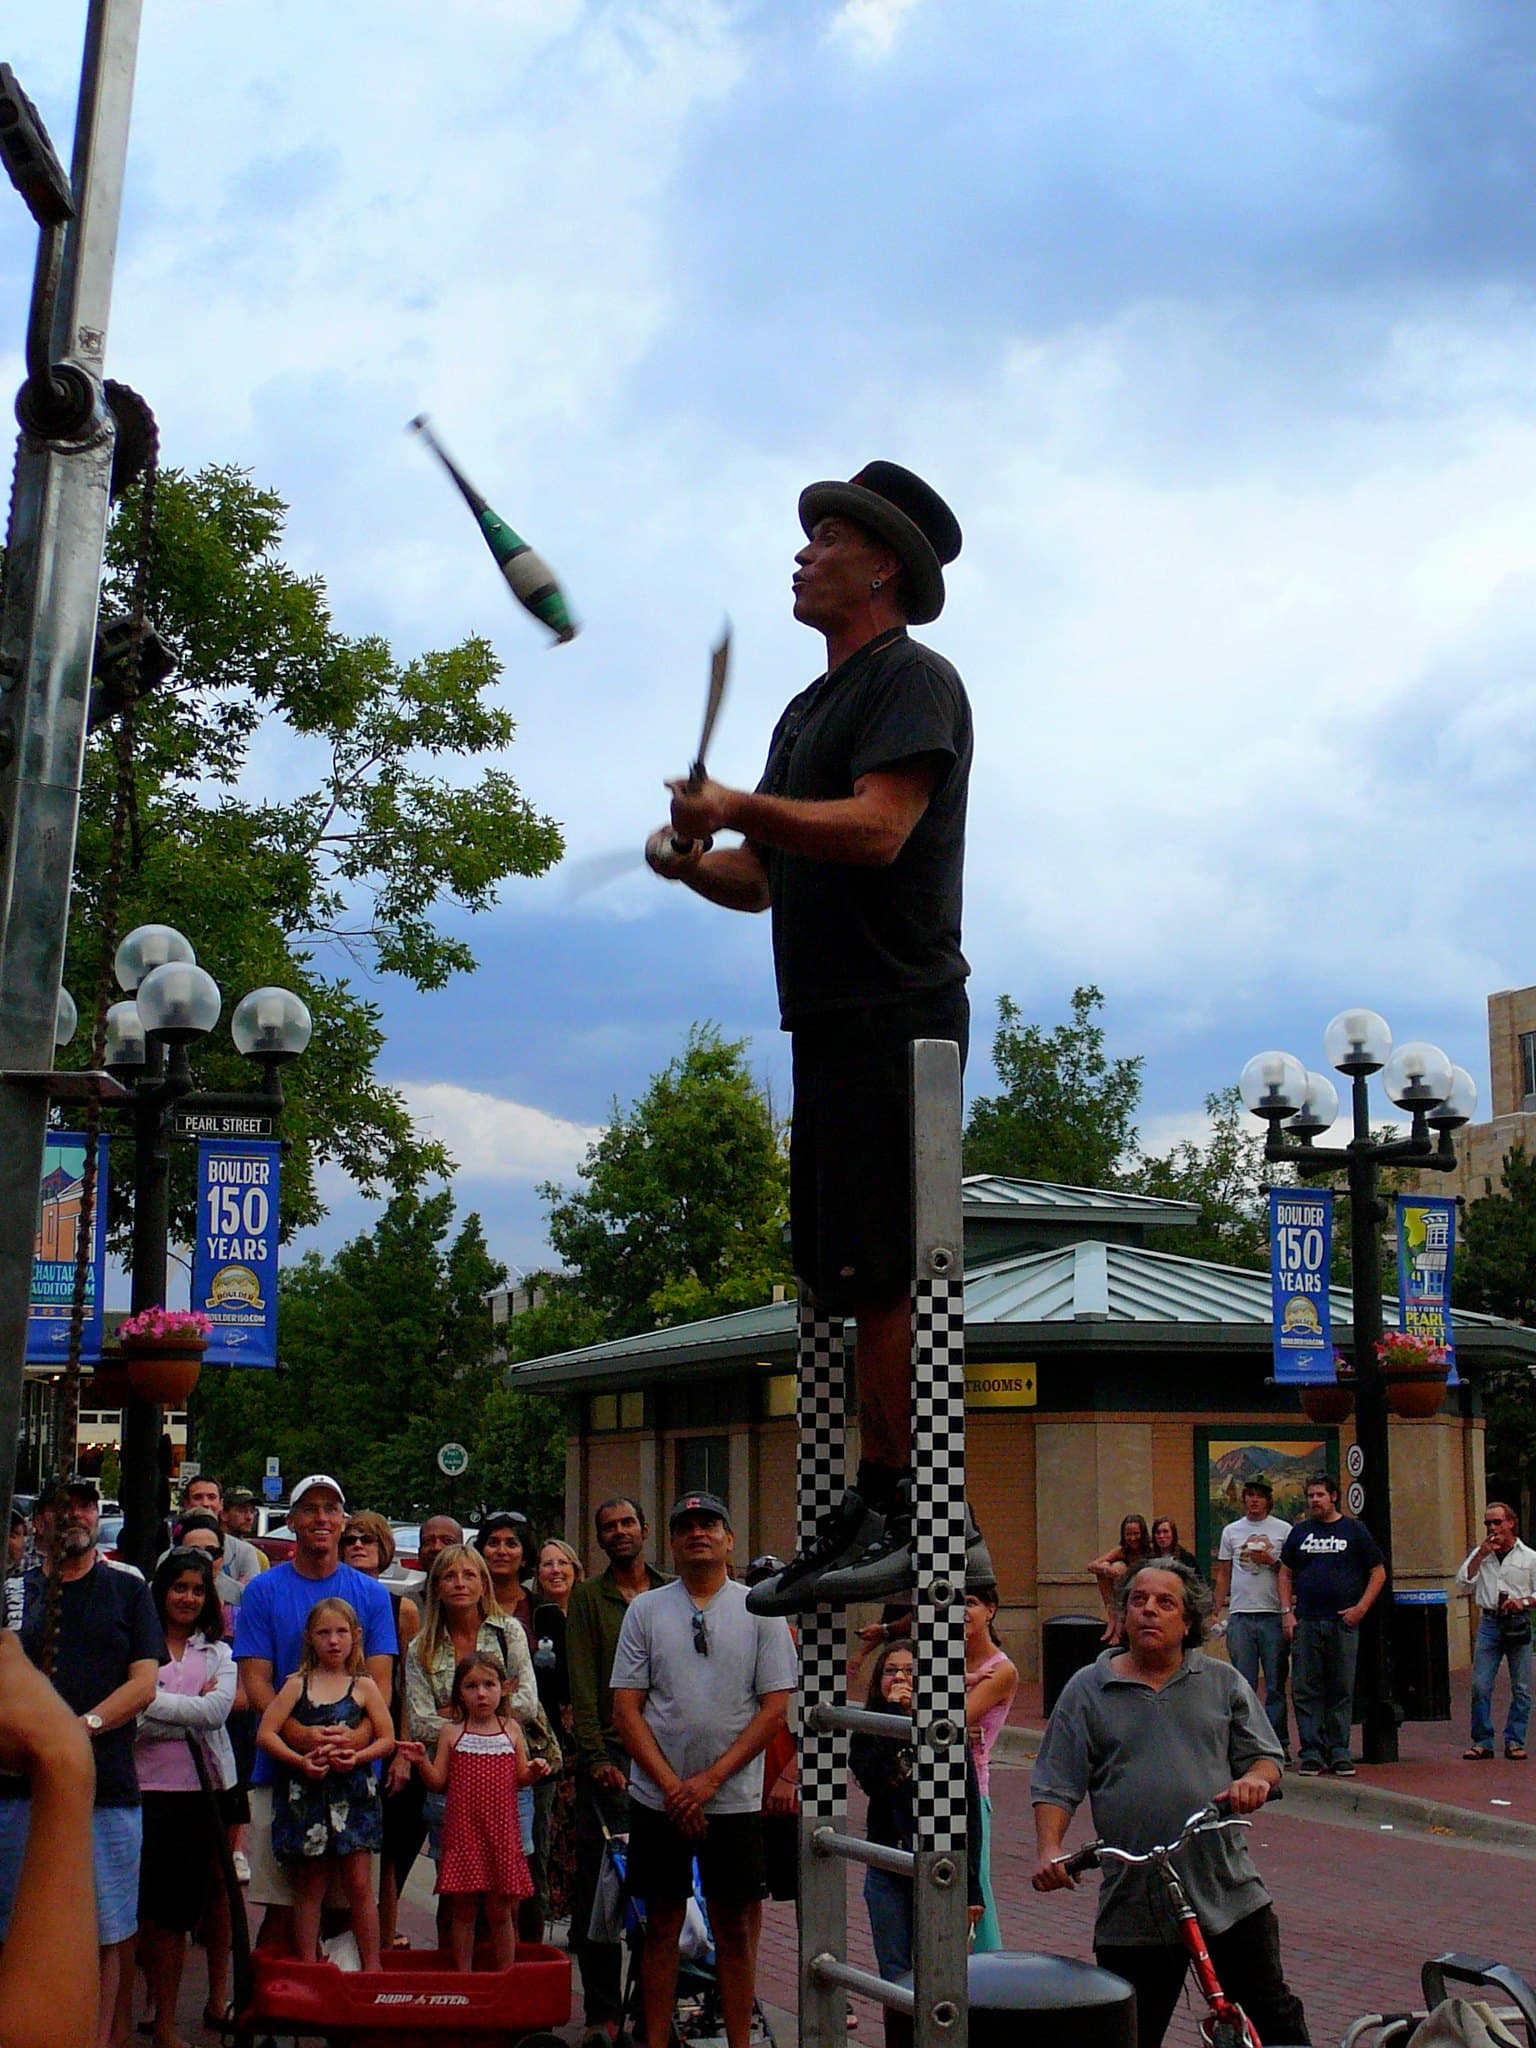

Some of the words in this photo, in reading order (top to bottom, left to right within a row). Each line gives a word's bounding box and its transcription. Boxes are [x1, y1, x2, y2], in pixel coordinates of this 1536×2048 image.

[185, 1116, 219, 1131] PEARL
[222, 1118, 262, 1133] STREET
[208, 1160, 270, 1185] BOULDER
[207, 1185, 269, 1236] 150
[1277, 1205, 1324, 1227] BOULDER
[207, 1237, 268, 1261] YEARS
[1277, 1227, 1324, 1271] 150
[31, 1282, 95, 1296] AUDITORM
[1278, 1271, 1322, 1293] YEARS
[1405, 1312, 1446, 1326] PEARL
[1406, 1326, 1446, 1337] STREET
[965, 1379, 1023, 1392] TROOMS
